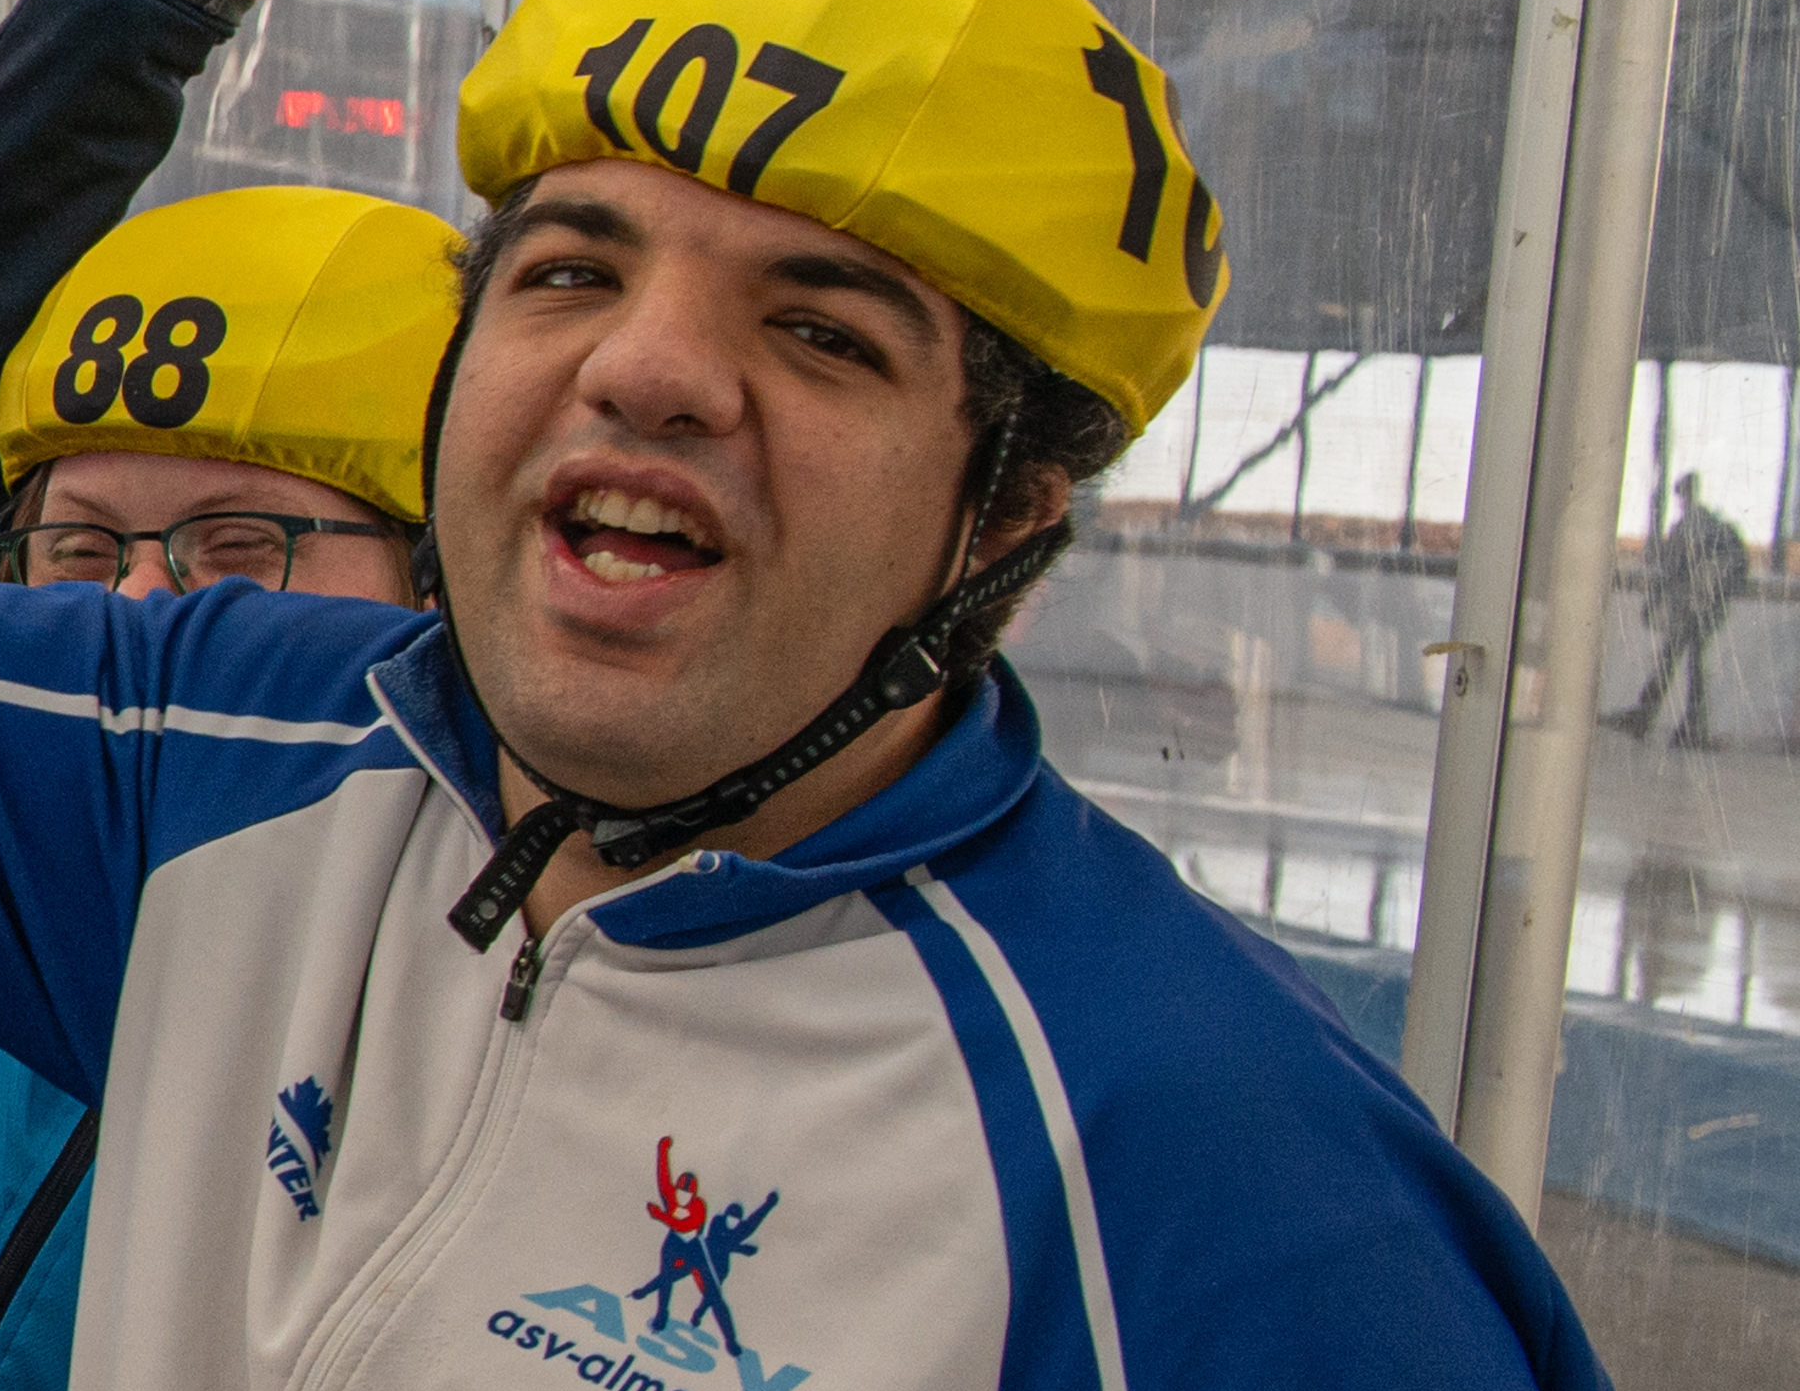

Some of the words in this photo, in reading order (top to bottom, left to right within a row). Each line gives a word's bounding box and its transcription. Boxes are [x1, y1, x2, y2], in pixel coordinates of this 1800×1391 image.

[573, 17, 847, 199] 107
[1081, 22, 1227, 311] 10
[52, 294, 227, 429] 88
